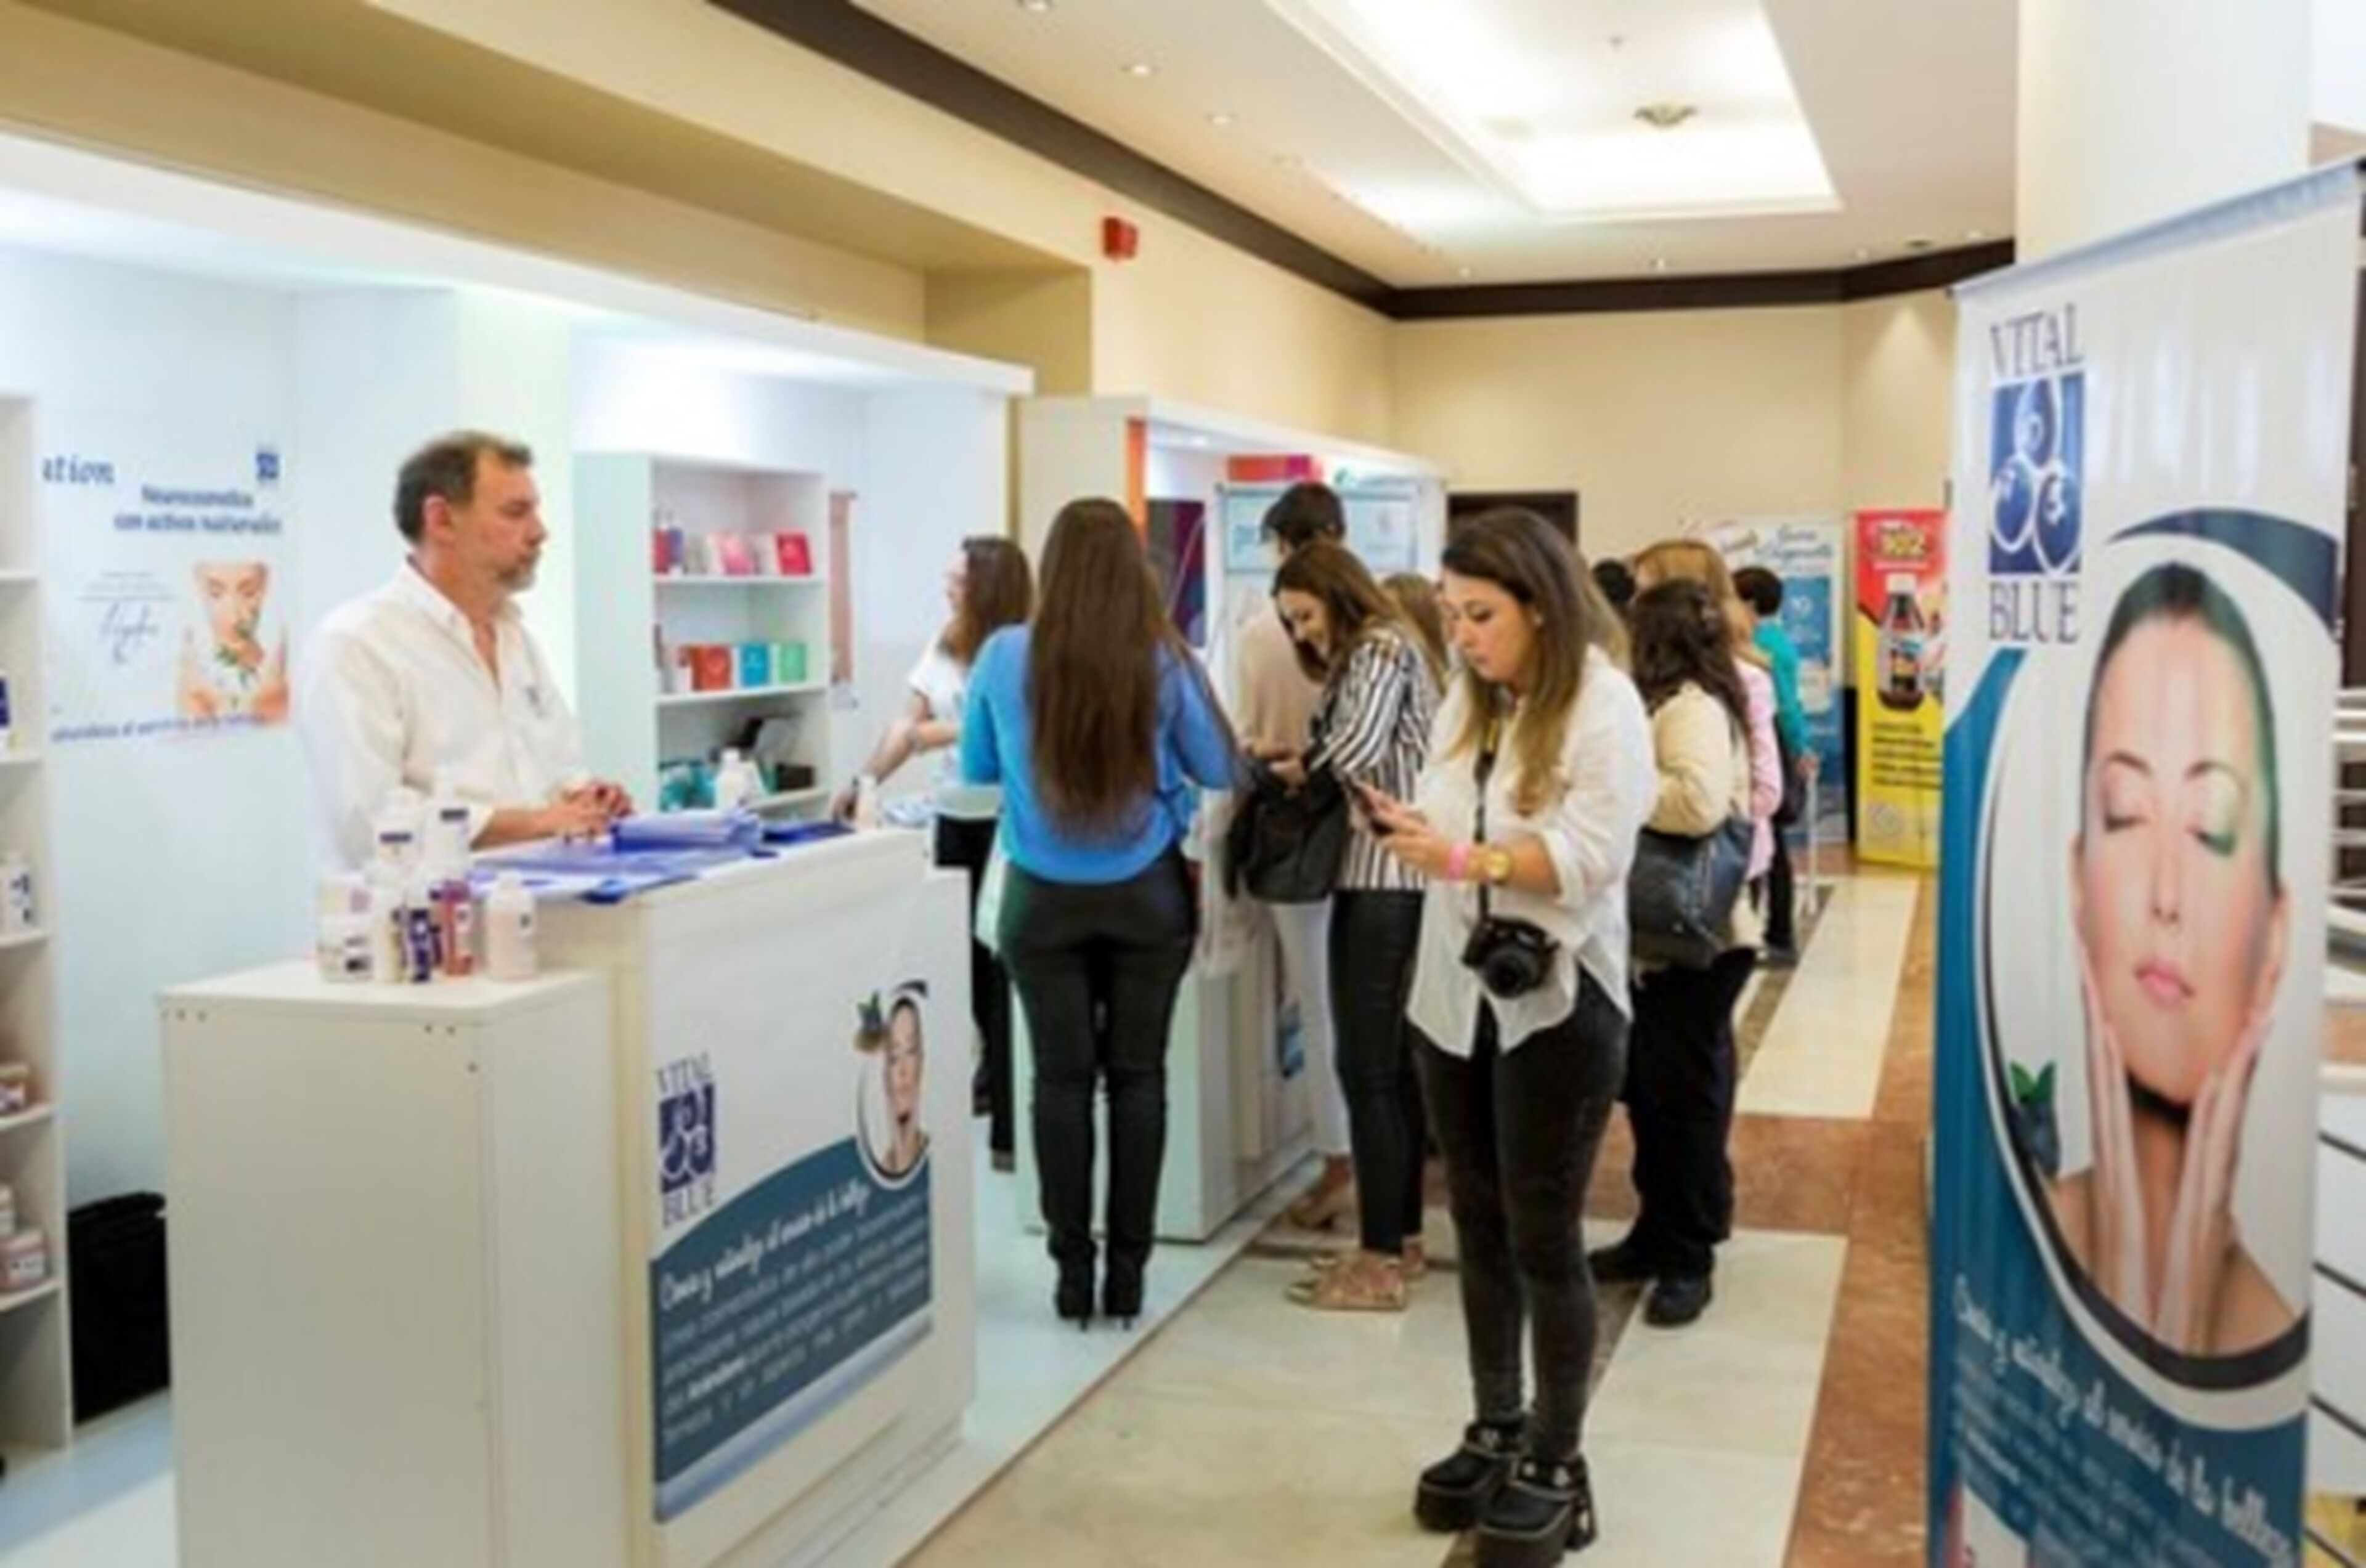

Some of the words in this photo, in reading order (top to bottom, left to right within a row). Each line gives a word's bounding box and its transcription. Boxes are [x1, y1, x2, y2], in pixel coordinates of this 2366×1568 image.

[1990, 303, 2085, 376] VITAL
[1990, 581, 2081, 643] BLUE
[662, 1177, 713, 1228] BLUE
